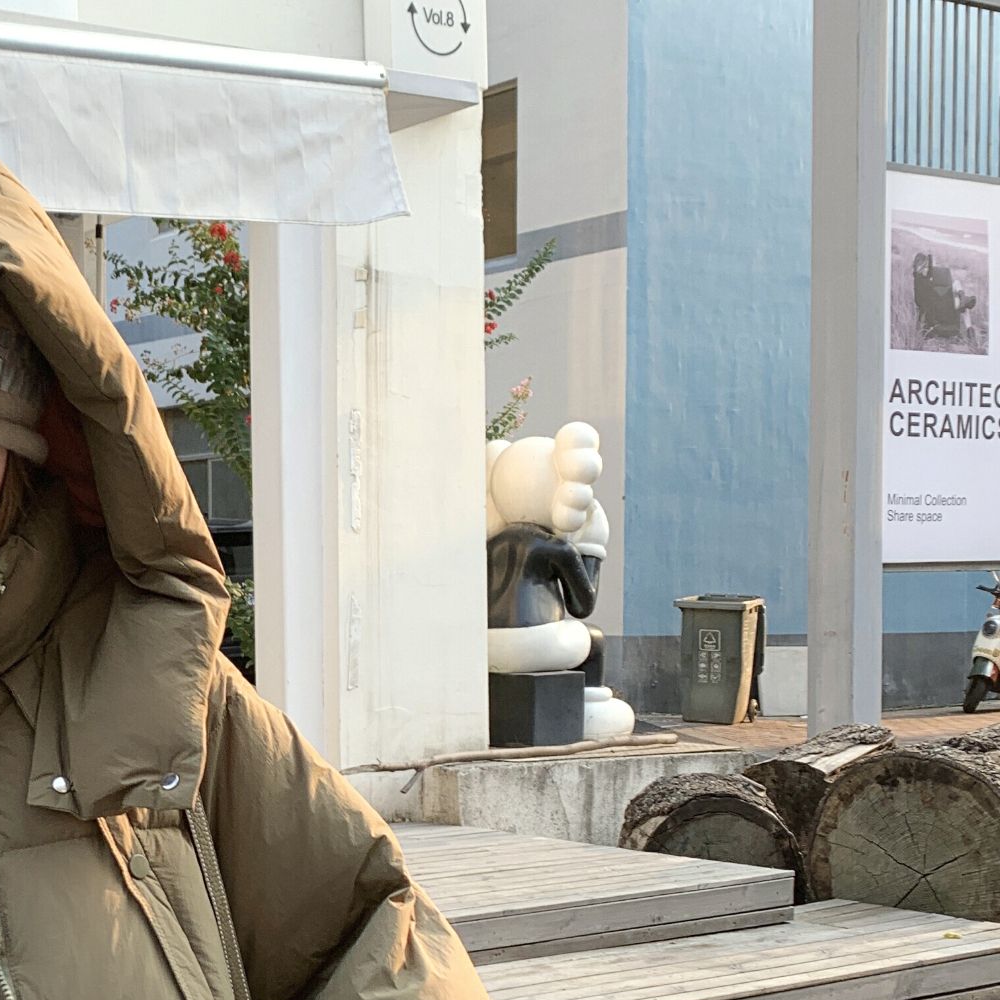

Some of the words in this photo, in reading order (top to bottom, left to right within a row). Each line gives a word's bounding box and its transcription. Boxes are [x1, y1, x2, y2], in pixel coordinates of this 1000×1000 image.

[423, 7, 454, 27] Vol.8
[889, 411, 1000, 440] CERAMIC
[887, 493, 922, 506] Minimal
[924, 494, 967, 506] Collection
[887, 509, 914, 522] Share
[916, 512, 943, 525] space
